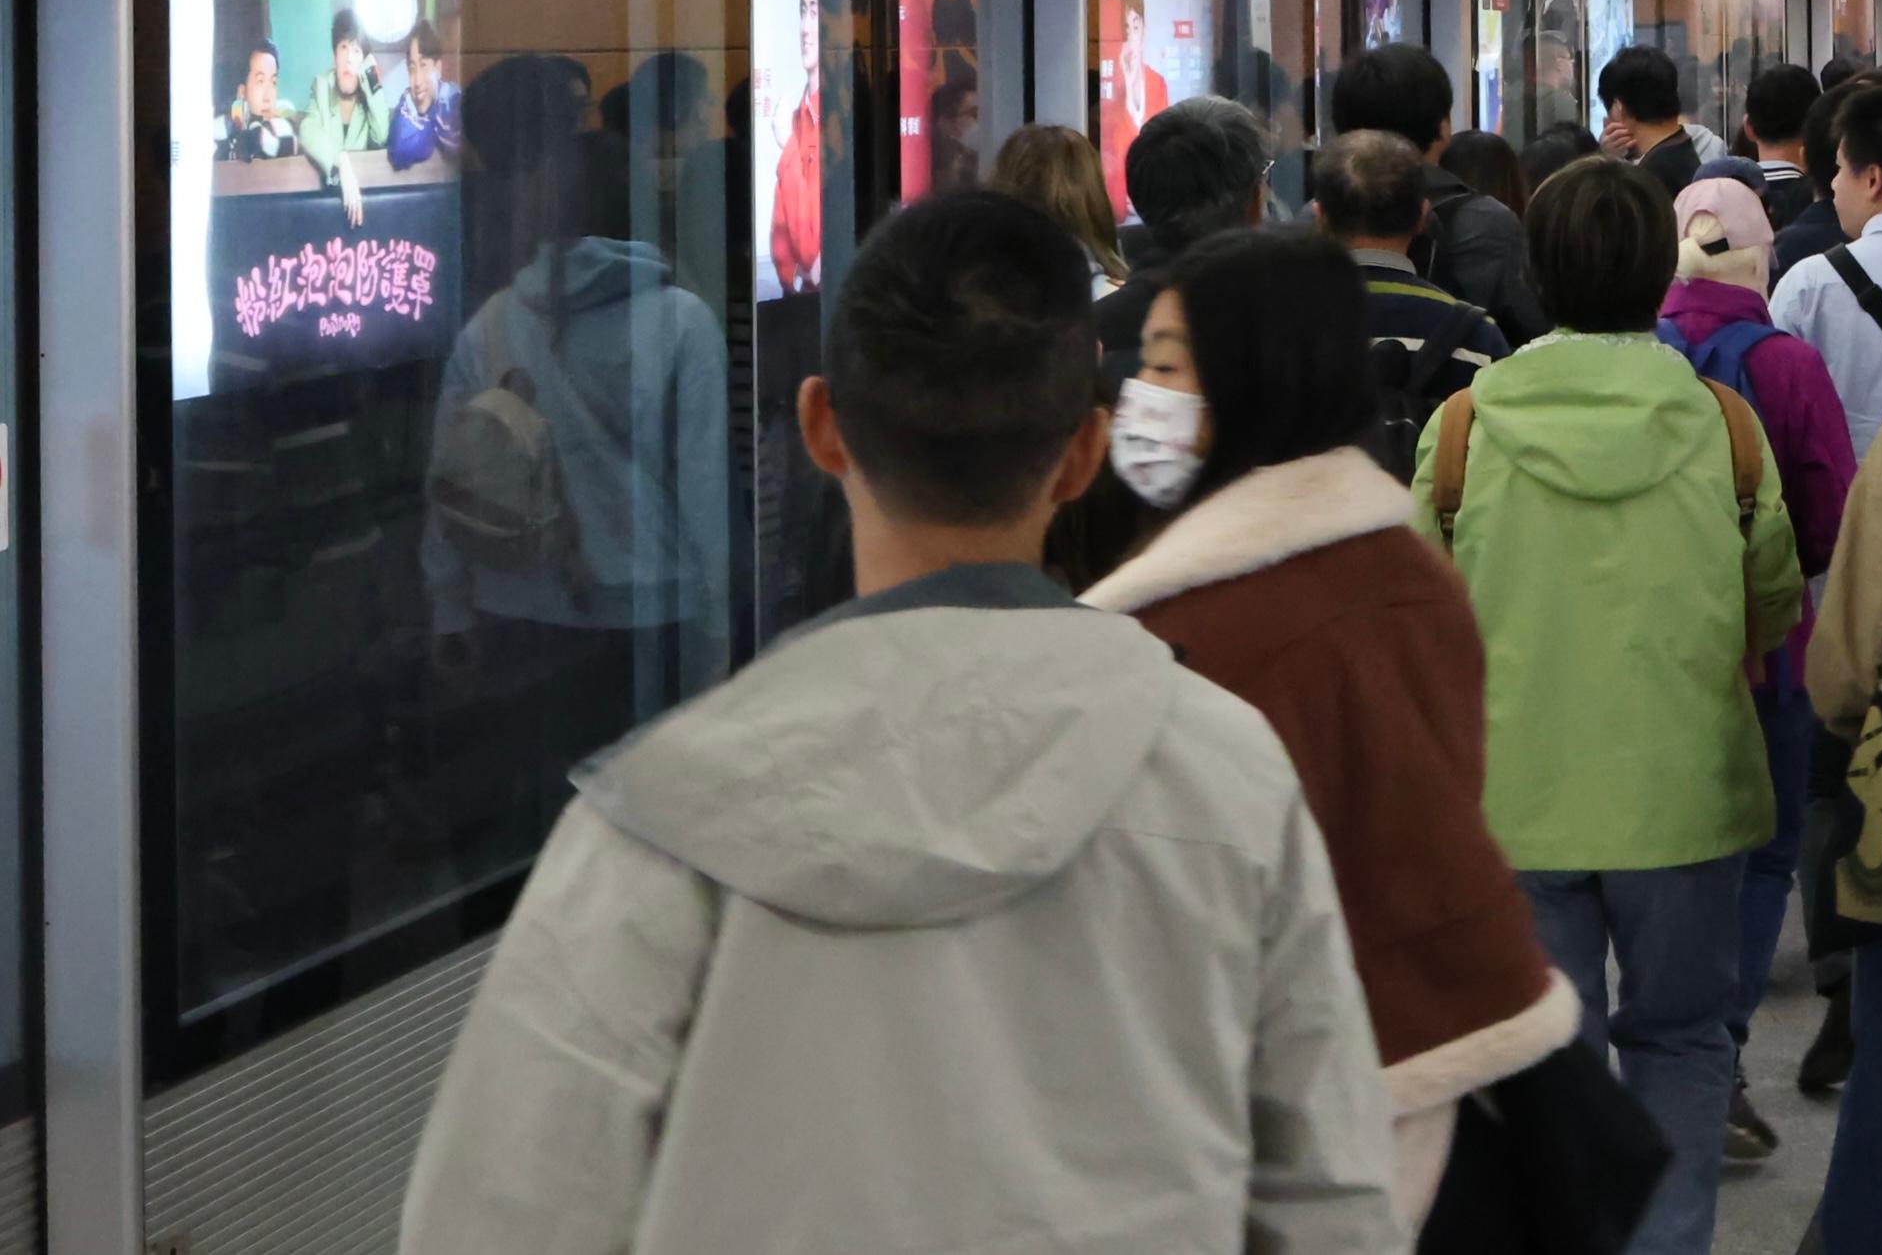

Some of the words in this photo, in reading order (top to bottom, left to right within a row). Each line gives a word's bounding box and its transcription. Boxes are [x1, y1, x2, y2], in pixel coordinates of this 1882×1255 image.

[235, 236, 436, 337] 粉紅泡泡防護罩
